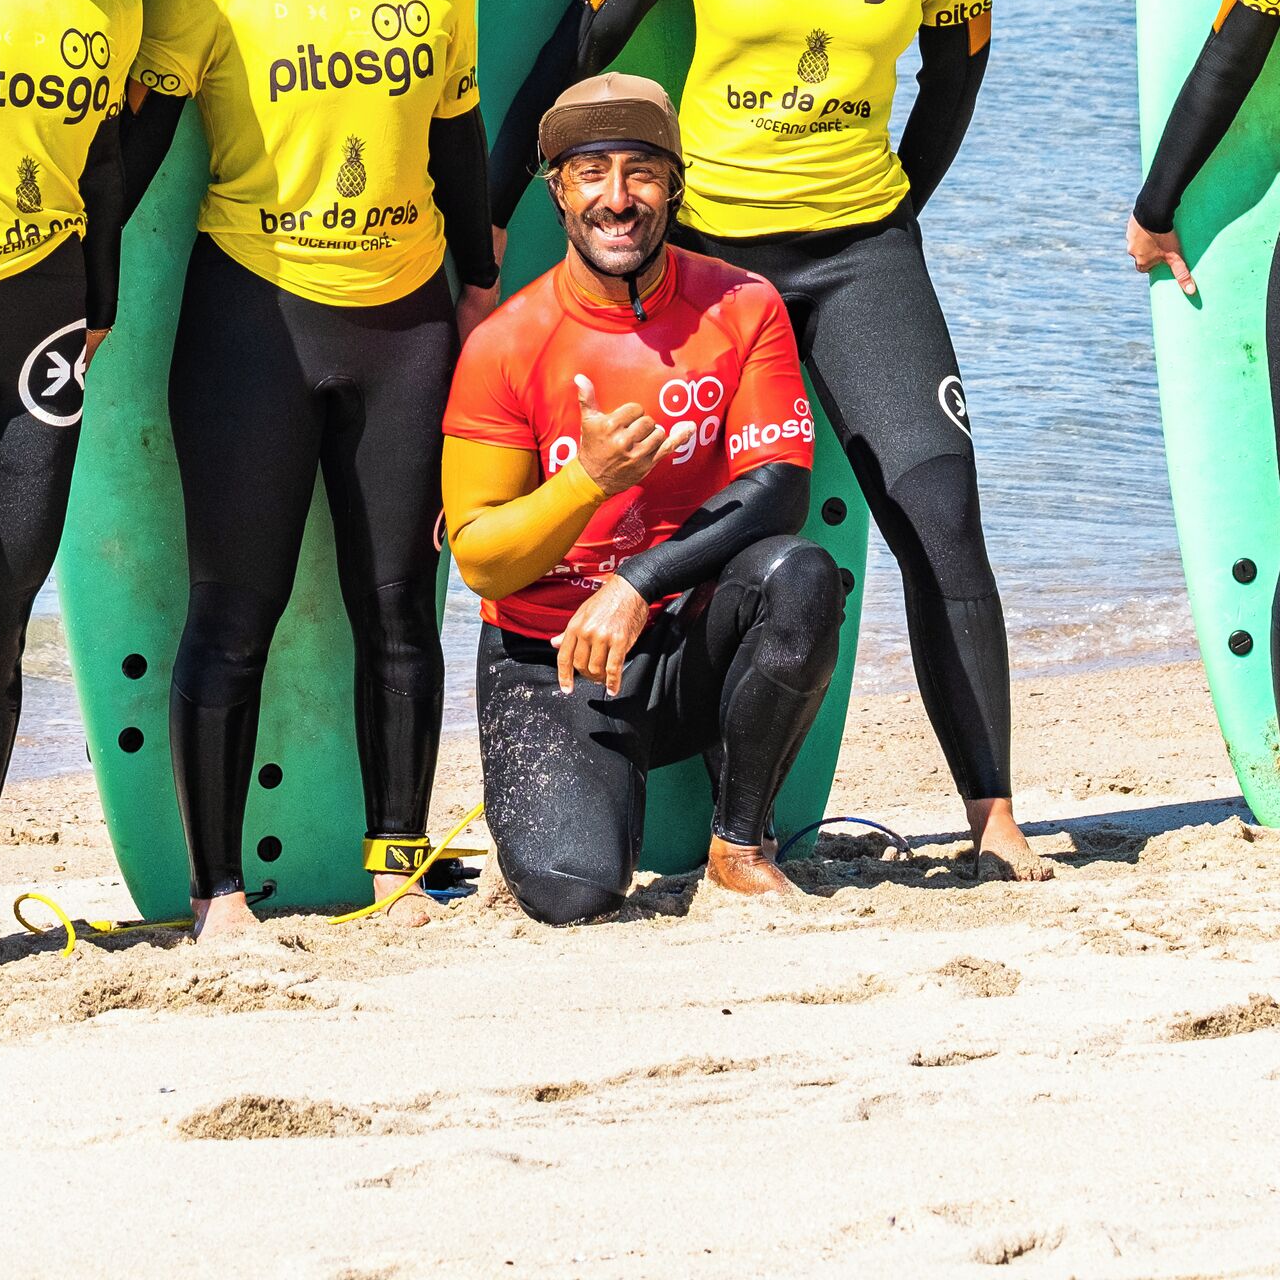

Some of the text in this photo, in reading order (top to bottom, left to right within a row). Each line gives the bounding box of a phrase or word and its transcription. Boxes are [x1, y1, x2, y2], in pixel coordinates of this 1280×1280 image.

[269, 42, 434, 103] pitosga
[727, 84, 773, 110] bar
[781, 85, 815, 112] da
[809, 118, 843, 134] CAFÉ
[259, 199, 419, 236] bar da praia
[728, 417, 816, 461] pitosg
